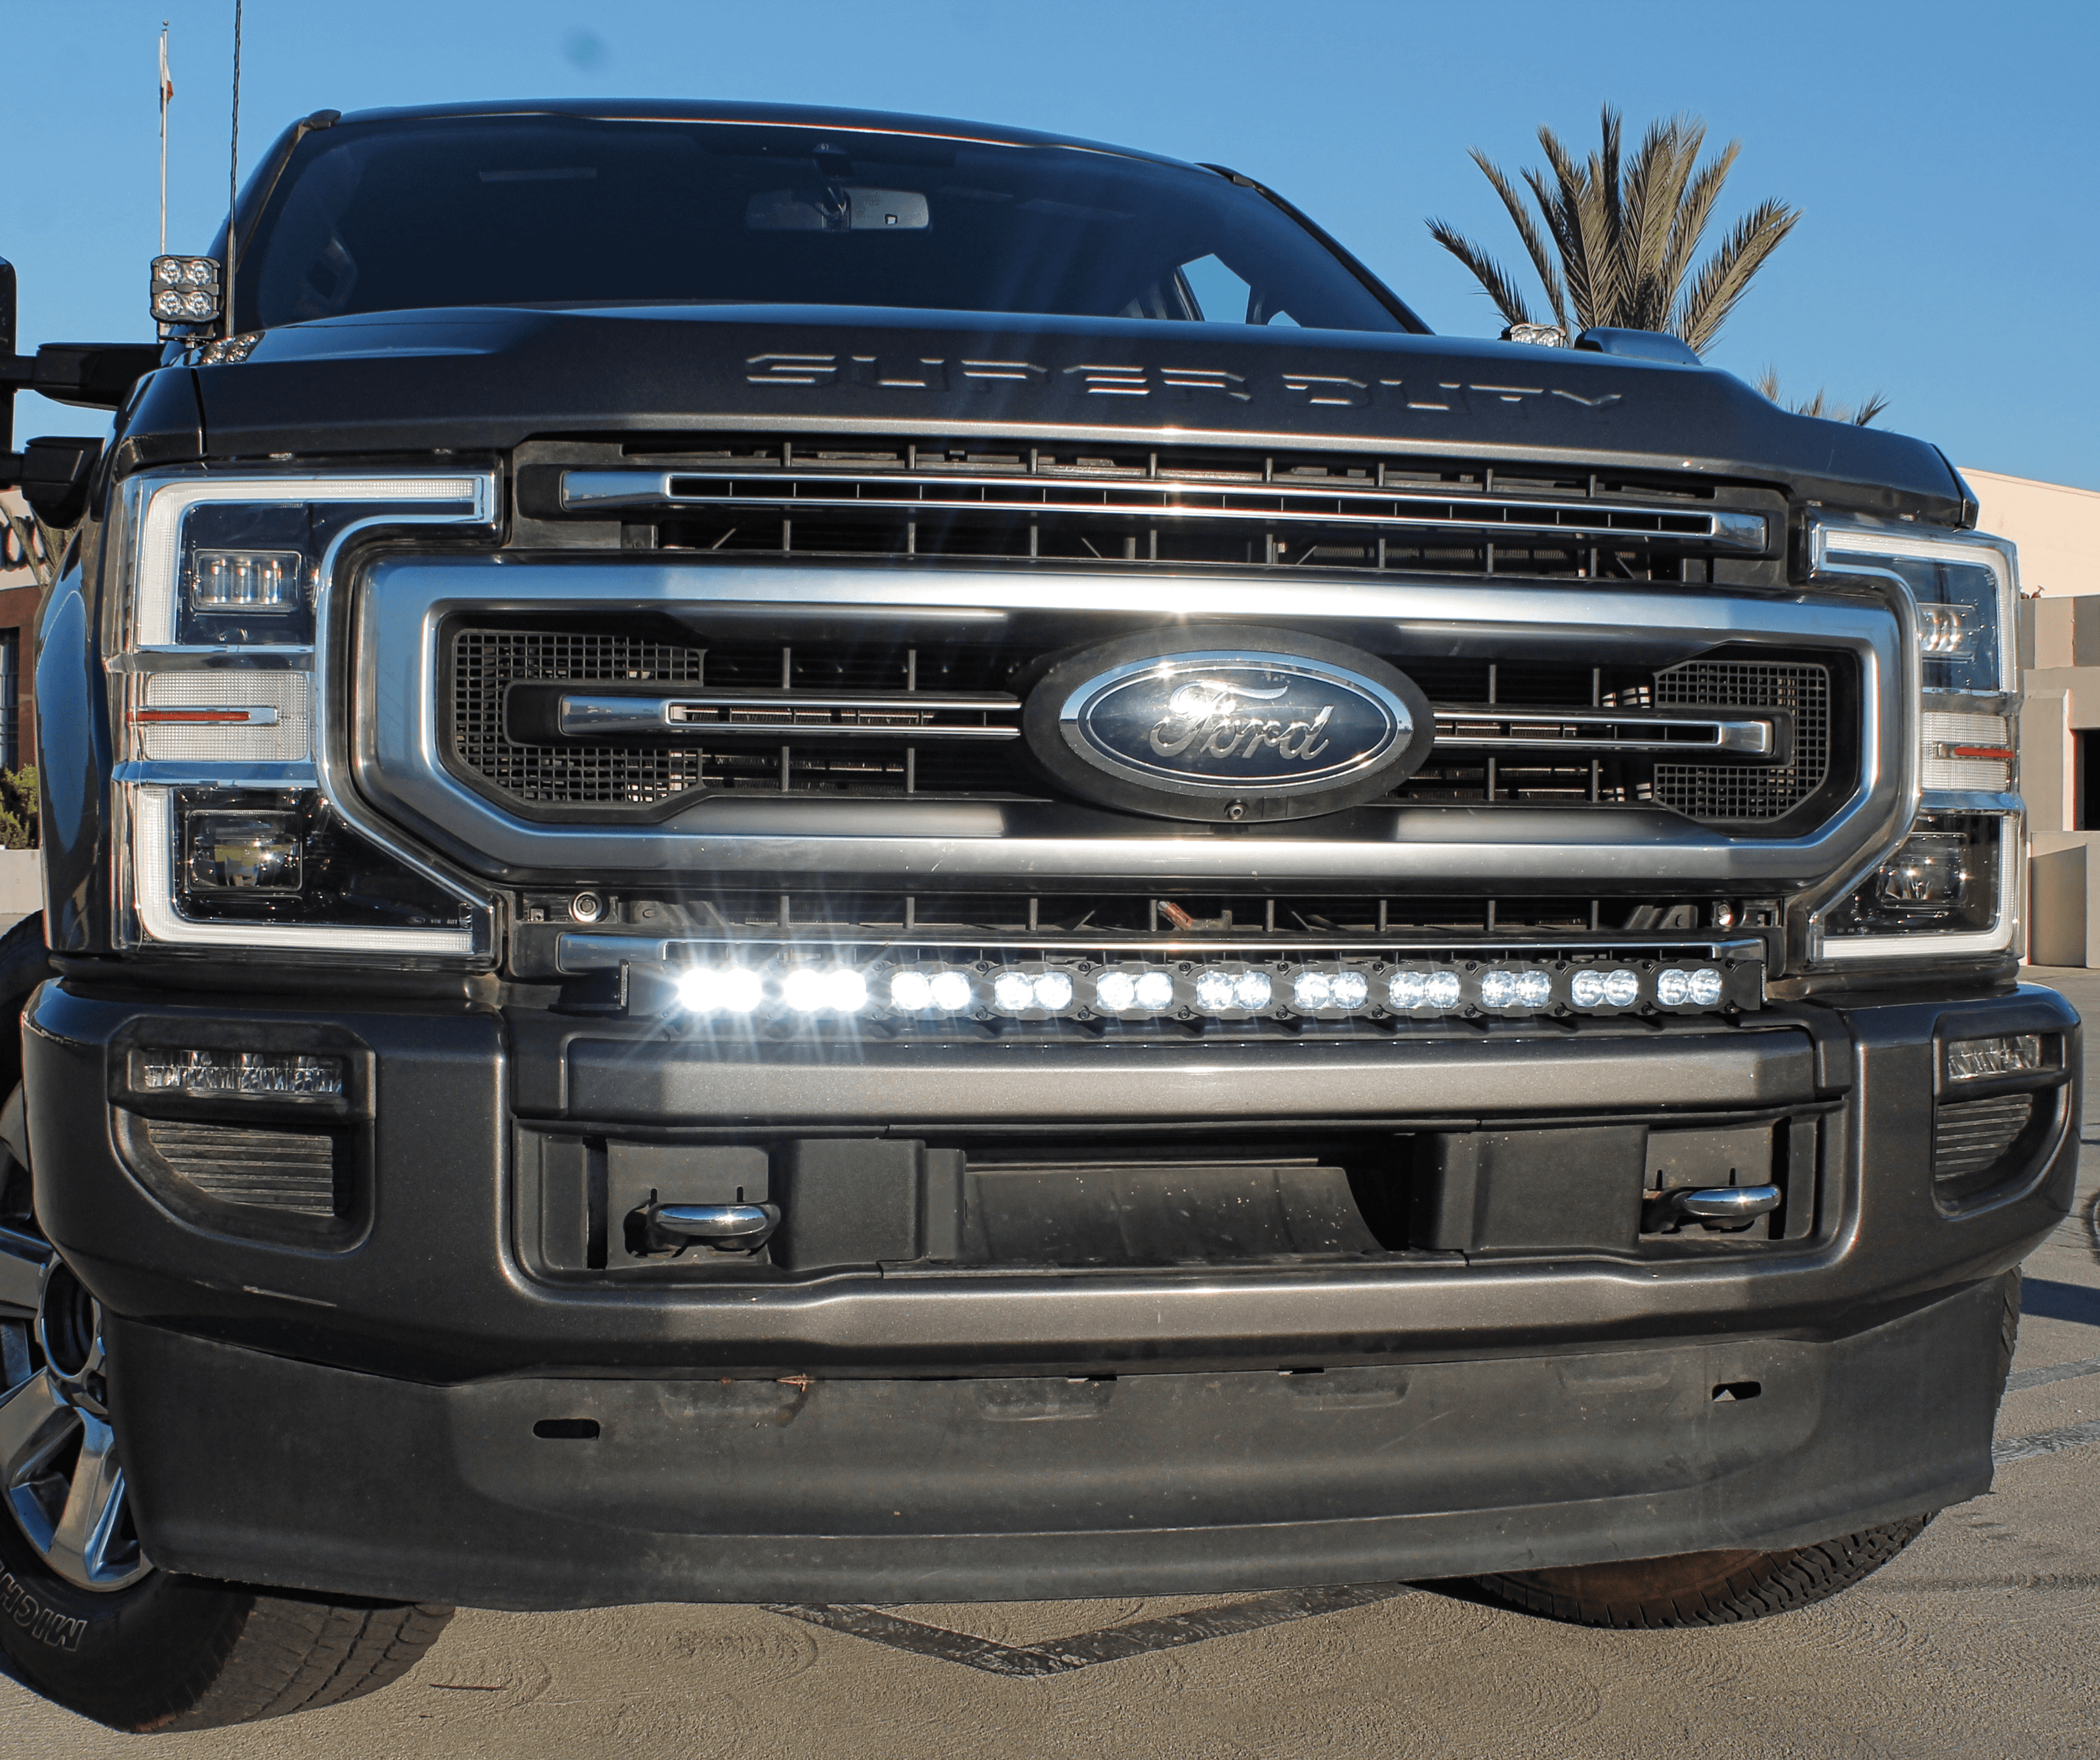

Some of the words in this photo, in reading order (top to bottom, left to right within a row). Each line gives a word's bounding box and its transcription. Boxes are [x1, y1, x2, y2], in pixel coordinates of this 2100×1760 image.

[745, 353, 1251, 402] SUPER
[1281, 373, 1624, 420] DUTY
[1149, 679, 1335, 760] Ford
[0, 1560, 87, 1652] MICH
